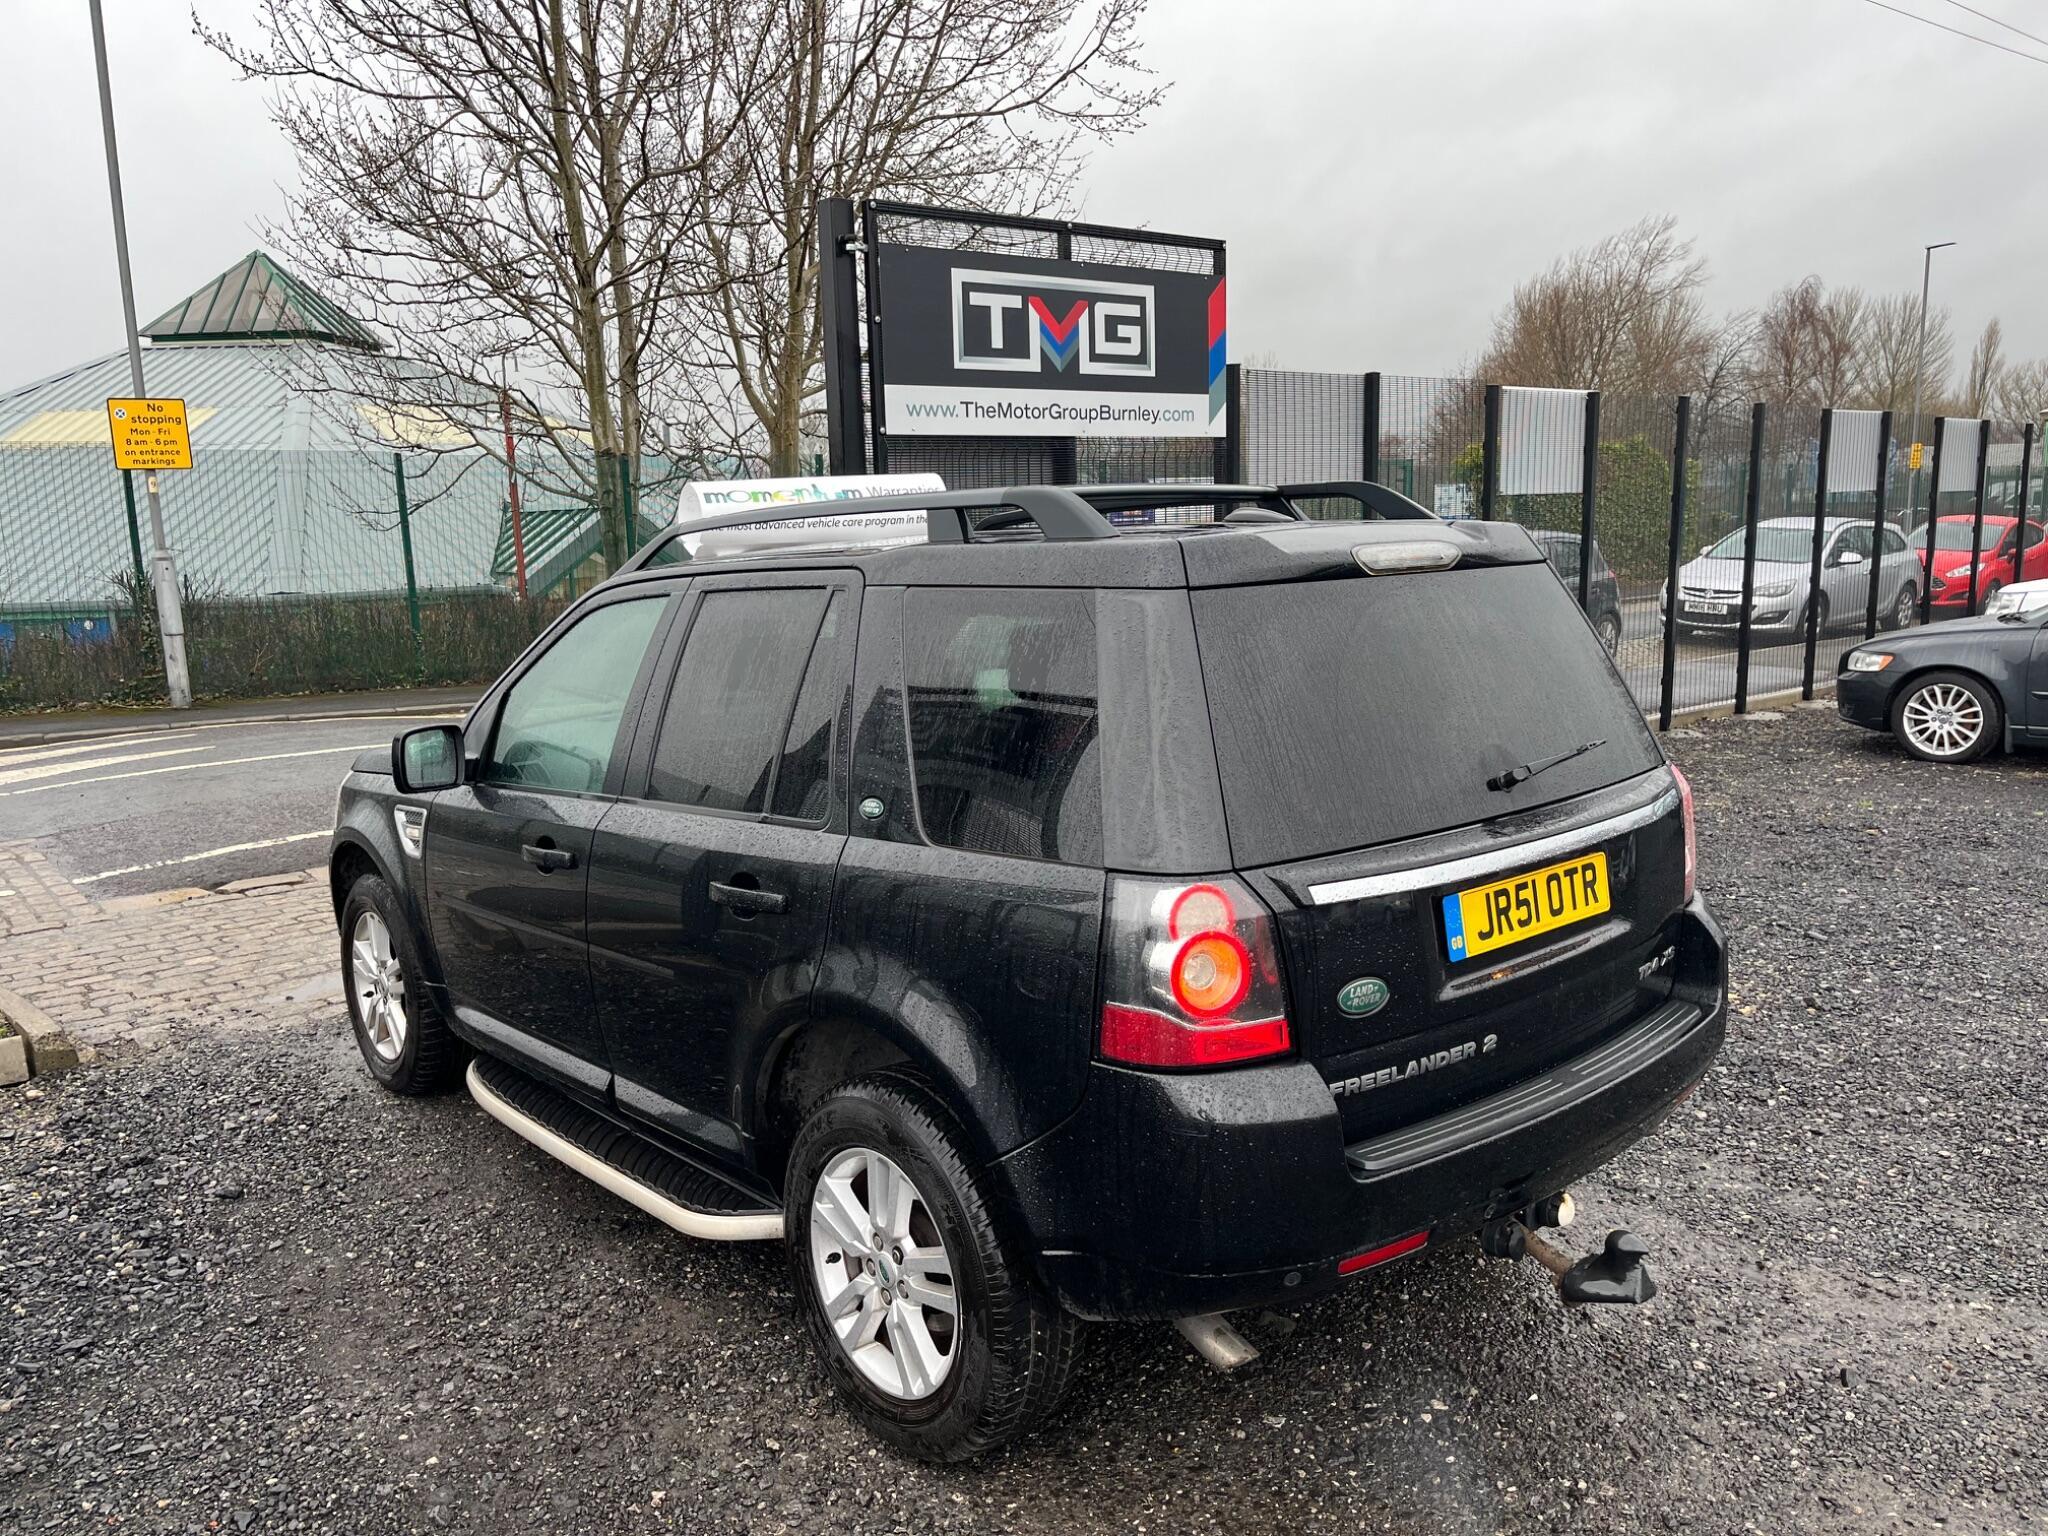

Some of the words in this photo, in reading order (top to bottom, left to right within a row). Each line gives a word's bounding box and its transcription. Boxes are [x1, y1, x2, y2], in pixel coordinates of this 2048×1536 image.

[968, 290, 1142, 373] TMG
[147, 403, 164, 413] No
[905, 401, 1196, 425] www.TheMotorGroupBurnley.com
[131, 415, 182, 425] stopping
[130, 428, 151, 436] Mon
[158, 428, 171, 436] Fri
[132, 458, 176, 466] markings
[754, 518, 805, 530] advanced
[807, 517, 840, 529] vehicle
[842, 518, 864, 528] care
[865, 516, 905, 528] program
[906, 514, 915, 525] in
[1477, 878, 1542, 942] JR51
[1545, 861, 1600, 918] OTR
[1328, 1041, 1477, 1098] FREELANDER
[1482, 1033, 1499, 1053] 2
